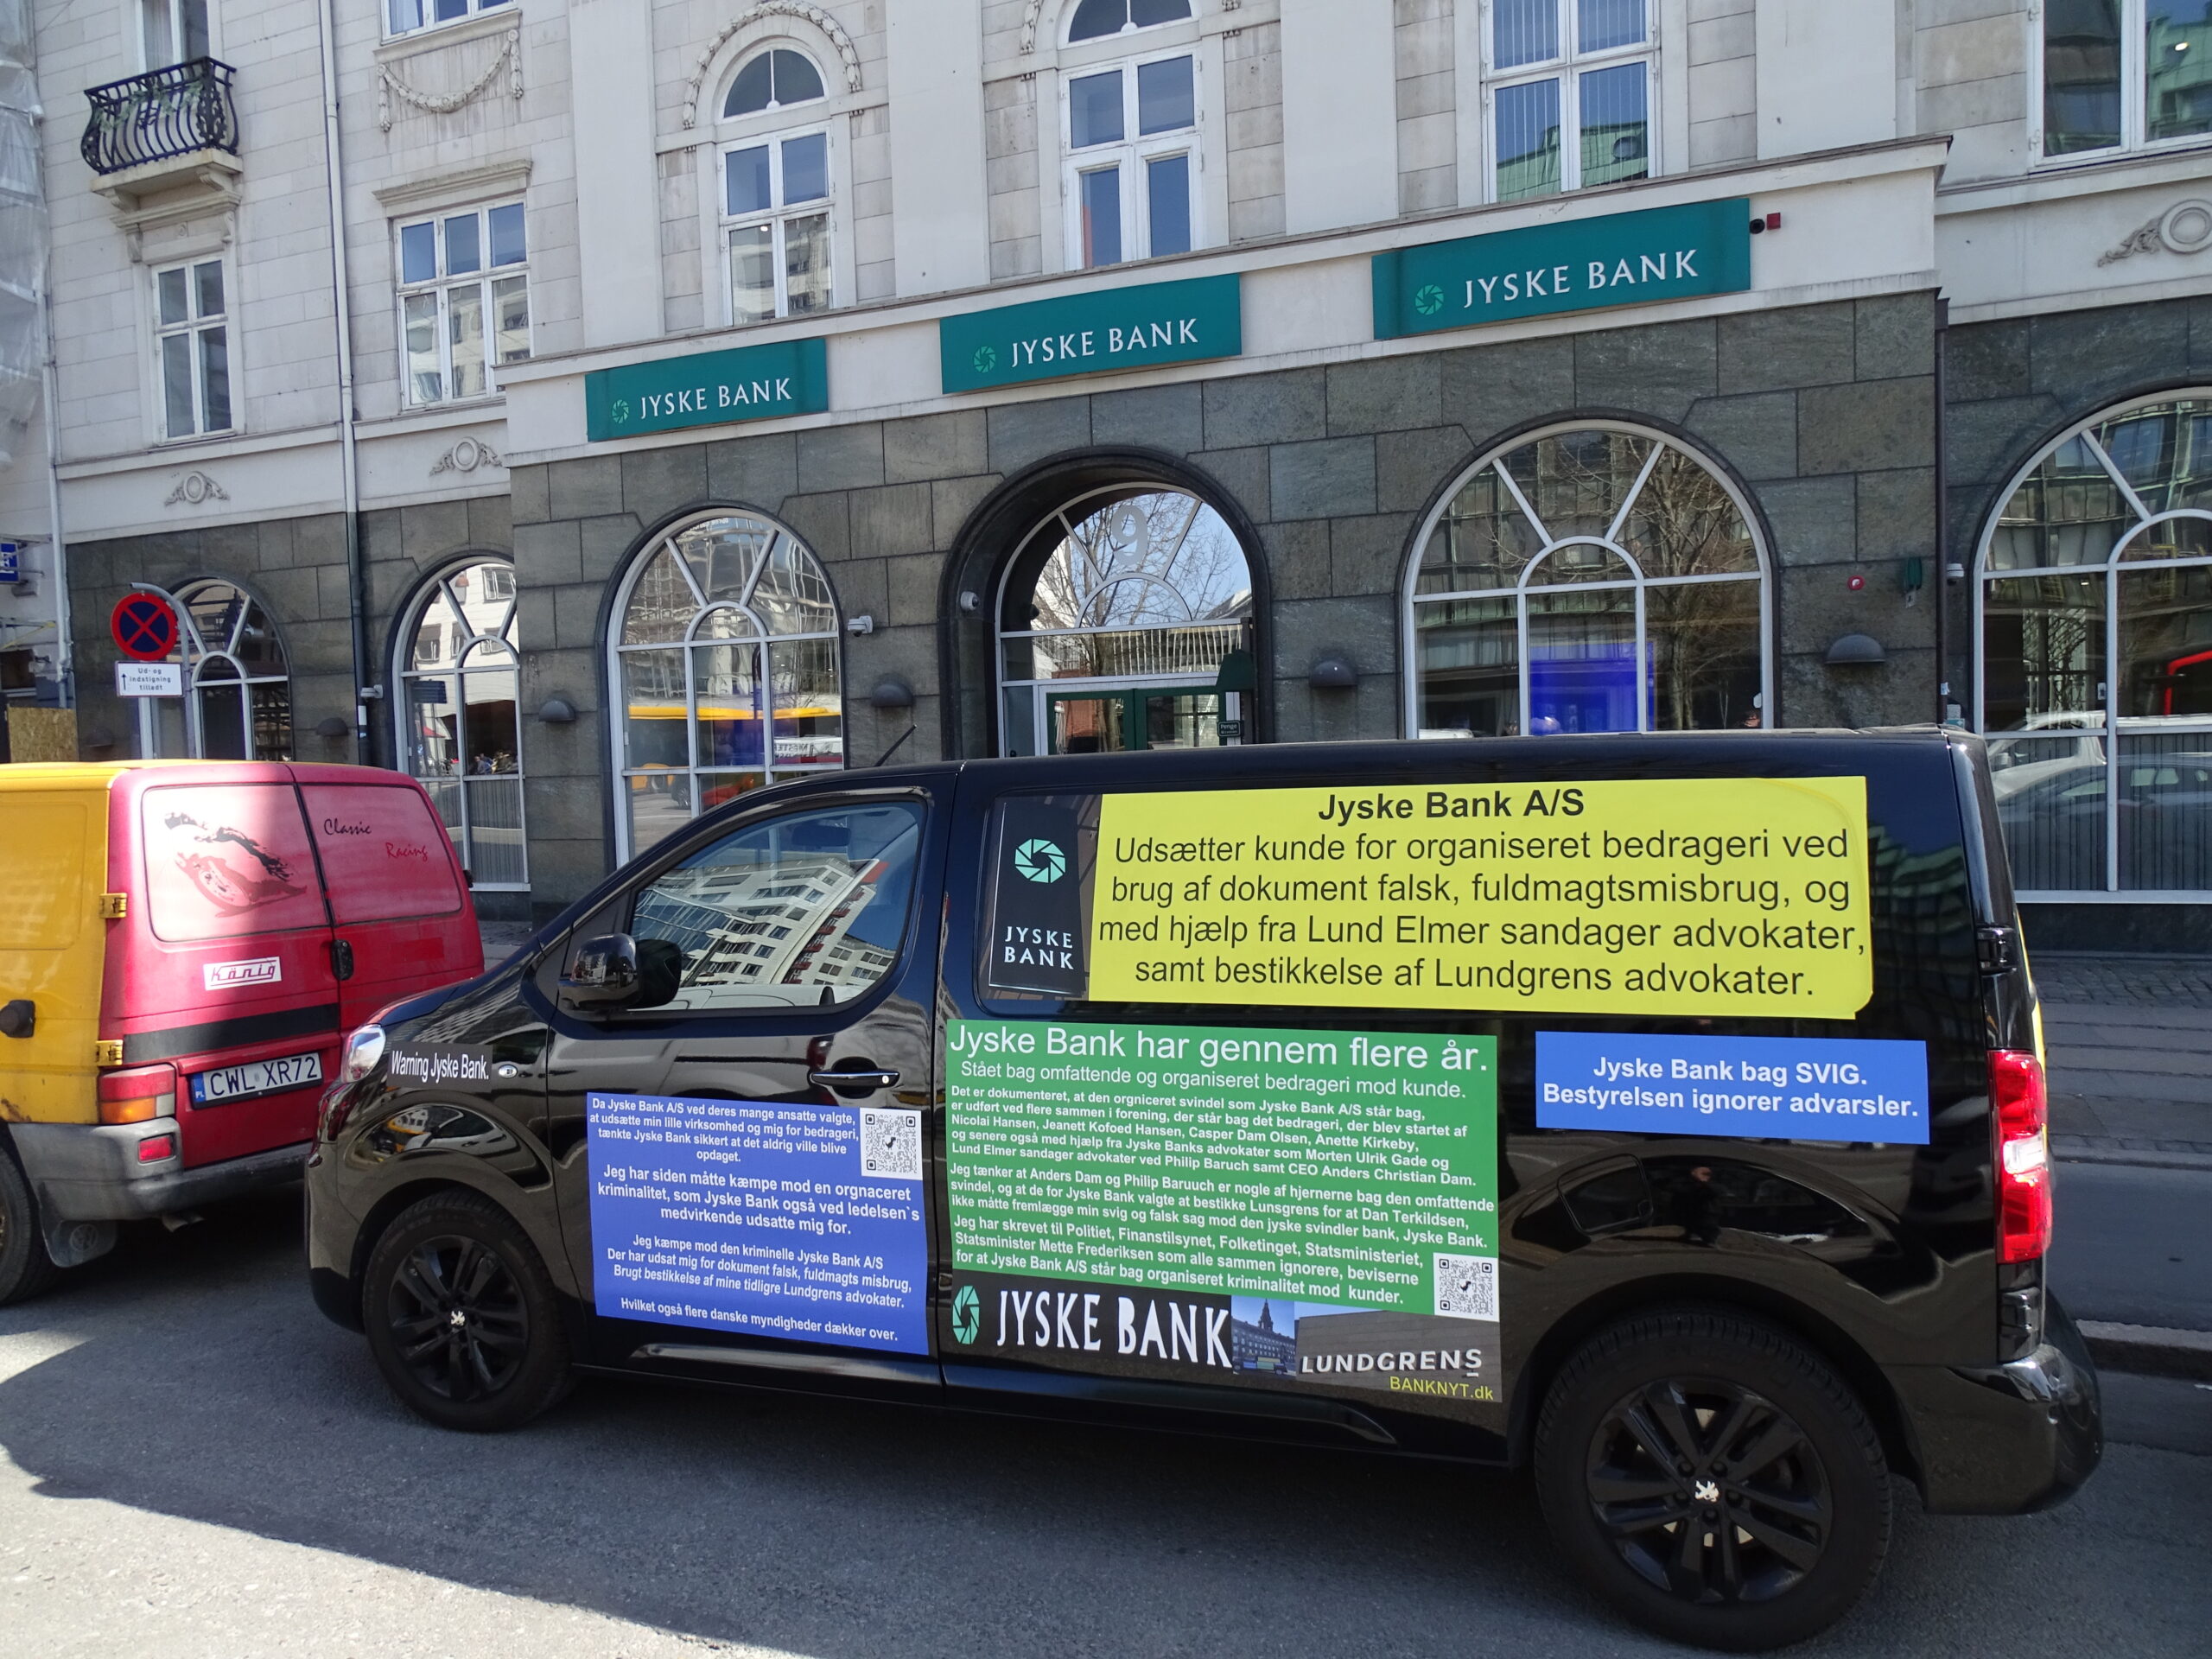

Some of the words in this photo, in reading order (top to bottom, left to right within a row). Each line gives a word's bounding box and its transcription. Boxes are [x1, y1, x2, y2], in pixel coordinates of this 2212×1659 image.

[1464, 265, 1569, 308] JYSKE
[1588, 249, 1699, 290] BANK
[1011, 331, 1094, 368] JYSKE
[1109, 318, 1199, 353] BANK
[640, 387, 708, 420] JYSKE
[718, 378, 793, 409] BANK
[1110, 504, 1147, 567] 9
[1318, 793, 1414, 827] Jyske
[1426, 790, 1512, 818] Bank
[1522, 788, 1585, 817] A/S
[323, 817, 372, 836] Classic
[385, 842, 429, 862] Racing
[1116, 836, 1246, 863] Udsætter
[1255, 833, 1345, 861] kunde
[1356, 832, 1397, 861] for
[1407, 831, 1591, 867] organiseret
[1604, 829, 1769, 866] bedrageri
[1782, 828, 1847, 858] ved
[1112, 875, 1173, 909] brug
[1183, 874, 1212, 902] af
[1219, 874, 1368, 902] dokument
[1377, 873, 1459, 906] falsk,
[1471, 873, 1789, 911] fuldmagtsmisbrug,
[1805, 880, 1849, 912] og
[1004, 925, 1073, 949] JYSKE
[1099, 915, 1159, 942] med
[1170, 915, 1248, 949] hjælp
[1258, 914, 1296, 943] fra
[1308, 915, 1383, 944] Lund
[1396, 915, 1491, 944] Elmer
[1501, 916, 1662, 954] sandager
[1673, 918, 1864, 956] advokater,
[210, 963, 276, 982] König
[1003, 946, 1074, 969] BANK
[1135, 957, 1205, 982] samt
[1215, 956, 1382, 986] bestikkelse
[1395, 957, 1426, 987] af
[1435, 958, 1611, 997] Lundgrens
[1624, 962, 1813, 995] advokater.
[391, 1049, 429, 1084] Warning
[430, 1052, 459, 1084] Jyske
[461, 1052, 490, 1081] Bank.
[950, 1025, 1036, 1058] Jyske
[1047, 1027, 1126, 1057] Bank
[1137, 1030, 1190, 1059] har
[1199, 1039, 1338, 1068] gennem
[1349, 1036, 1428, 1069] flere
[1440, 1038, 1489, 1071] år.
[209, 1066, 257, 1097] CWL
[262, 1055, 318, 1088] XR72
[961, 1060, 1002, 1077] Stået
[1007, 1062, 1035, 1084] bag
[1040, 1065, 1132, 1084] omfattende
[1136, 1071, 1157, 1089] og
[1162, 1071, 1260, 1090] organiseret
[1265, 1072, 1350, 1096] bedrageri
[1357, 1077, 1396, 1096] mod
[1402, 1078, 1466, 1098] kunde.
[1593, 1057, 1663, 1082] Jyske
[1671, 1058, 1734, 1081] Bank
[1741, 1061, 1788, 1088] bag
[1796, 1062, 1867, 1085] SVIG.
[195, 1090, 205, 1099] PL
[592, 1097, 606, 1109] Da
[607, 1098, 637, 1113] Jyske
[639, 1100, 664, 1113] Bank
[666, 1102, 684, 1114] A/S
[686, 1103, 706, 1116] ved
[708, 1104, 737, 1117] deres
[739, 1109, 775, 1122] mange
[777, 1110, 817, 1122] ansatte
[819, 1111, 855, 1126] valgte,
[951, 1084, 970, 1097] Det
[973, 1089, 985, 1097] er
[988, 1087, 1071, 1103] dokumenteret,
[1073, 1091, 1085, 1103] at
[1088, 1091, 1110, 1103] den
[1179, 1096, 1224, 1109] svindel
[1228, 1100, 1255, 1110] som
[1259, 1099, 1298, 1115] Jyske
[1300, 1101, 1335, 1115] Bank
[1338, 1103, 1362, 1116] A/S
[1365, 1104, 1393, 1117] står
[1395, 1106, 1426, 1122] bag,
[1543, 1083, 1684, 1110] Bestyrelsen
[1692, 1088, 1783, 1115] ignorer
[1789, 1092, 1918, 1117] advarsler.
[696, 1149, 741, 1164] opdaget.
[598, 1181, 671, 1203] kriminalitet,
[673, 1191, 702, 1204] som
[704, 1190, 742, 1208] Jyske
[745, 1193, 779, 1210] Bank
[782, 1198, 816, 1215] også
[818, 1201, 844, 1215] ved
[603, 1164, 626, 1182] Jeg
[629, 1166, 650, 1180] har
[652, 1168, 687, 1184] siden
[690, 1171, 726, 1186] måtte
[729, 1173, 778, 1193] kæmpe
[781, 1179, 811, 1193] mod
[814, 1183, 831, 1195] en
[660, 1206, 743, 1225] medvirkende
[746, 1213, 796, 1230] udsatte
[798, 1217, 824, 1236] mig
[827, 1219, 851, 1235] for.
[632, 1234, 652, 1249] Jeg
[654, 1236, 692, 1253] kæmpe
[695, 1241, 718, 1253] mod
[720, 1242, 741, 1255] den
[742, 1243, 795, 1262] kriminelle
[797, 1249, 830, 1266] Jyske
[832, 1252, 861, 1268] Bank
[863, 1255, 884, 1270] A/S
[953, 1214, 976, 1231] Jeg
[979, 1216, 1000, 1230] har
[1002, 1218, 1049, 1235] skrevet
[1050, 1222, 1064, 1236] til
[1066, 1223, 1115, 1242] Politiet,
[1118, 1227, 1216, 1250] Finanstilsynet,
[1219, 1235, 1301, 1257] Folketinget,
[1305, 1242, 1424, 1268] Statsministeriet,
[955, 1231, 1037, 1251] Statsminister
[1039, 1238, 1074, 1255] Mette
[1077, 1242, 1154, 1262] Frederiksen
[1157, 1251, 1186, 1264] som
[1190, 1252, 1214, 1267] alle
[1217, 1256, 1276, 1272] sammen
[1280, 1258, 1344, 1281] ignorere,
[1347, 1264, 1419, 1286] beviserne
[956, 1249, 974, 1263] for
[976, 1252, 988, 1265] at
[990, 1252, 1027, 1269] Jyske
[1030, 1255, 1062, 1272] Bank
[1065, 1259, 1088, 1274] A/S
[1090, 1262, 1116, 1276] står
[1119, 1263, 1144, 1283] bag
[1147, 1269, 1224, 1287] organiseret
[1227, 1273, 1306, 1294] kriminalitet
[1308, 1283, 1340, 1298] mod
[1348, 1284, 1403, 1305] kunder.
[995, 1289, 1101, 1351] JYSKE
[1117, 1297, 1233, 1369] BANK
[1300, 1348, 1484, 1374] LUNDGRENS
[1388, 1374, 1495, 1402] BANKNYT.dk
